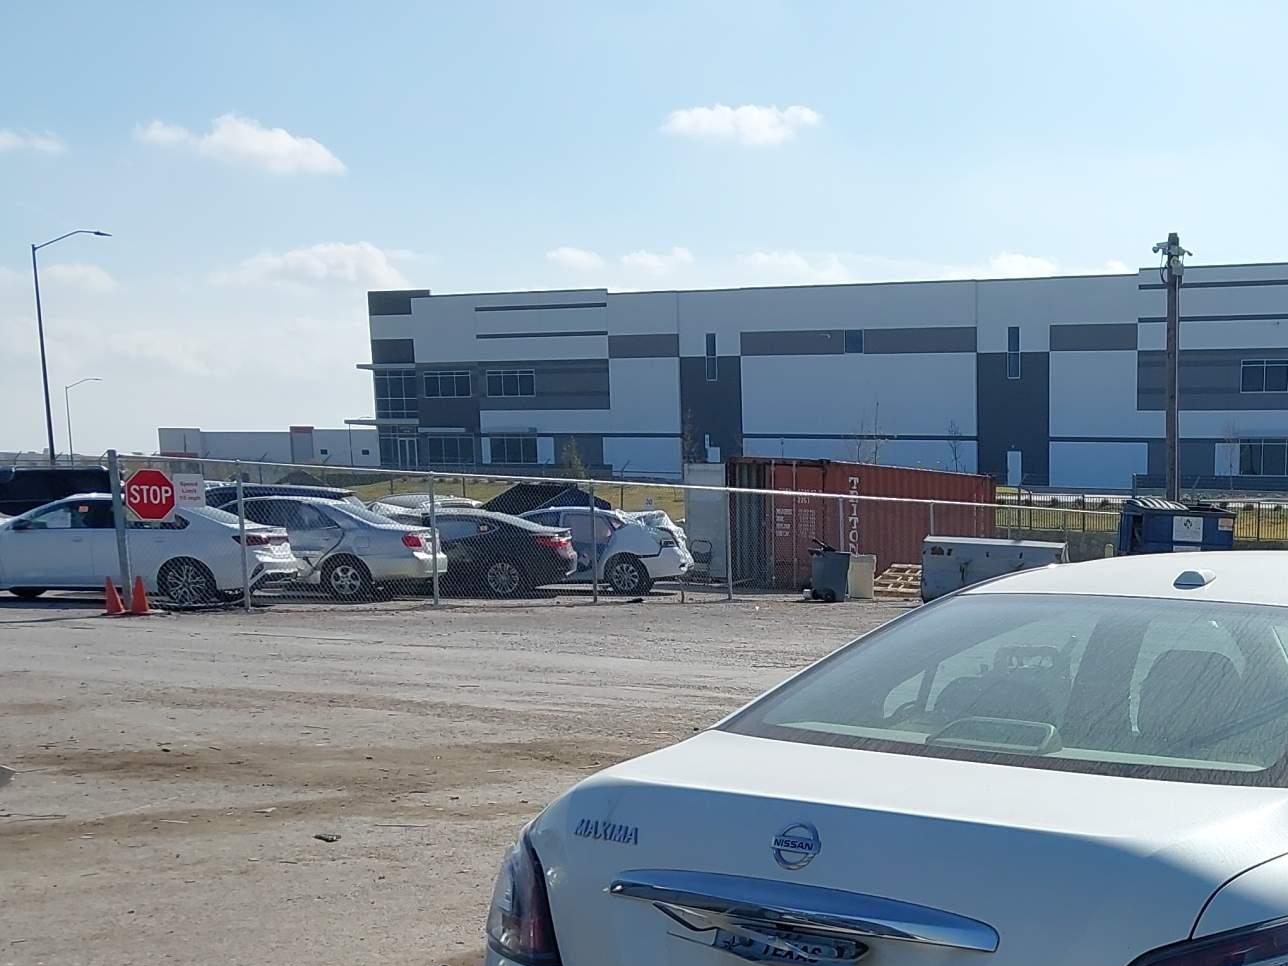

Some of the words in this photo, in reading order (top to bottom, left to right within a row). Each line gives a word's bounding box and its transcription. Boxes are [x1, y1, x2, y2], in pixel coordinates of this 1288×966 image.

[130, 484, 172, 505] STOP
[574, 818, 639, 846] MAXIMA
[773, 838, 814, 851] NISSAN
[762, 943, 822, 964] TEXAS
